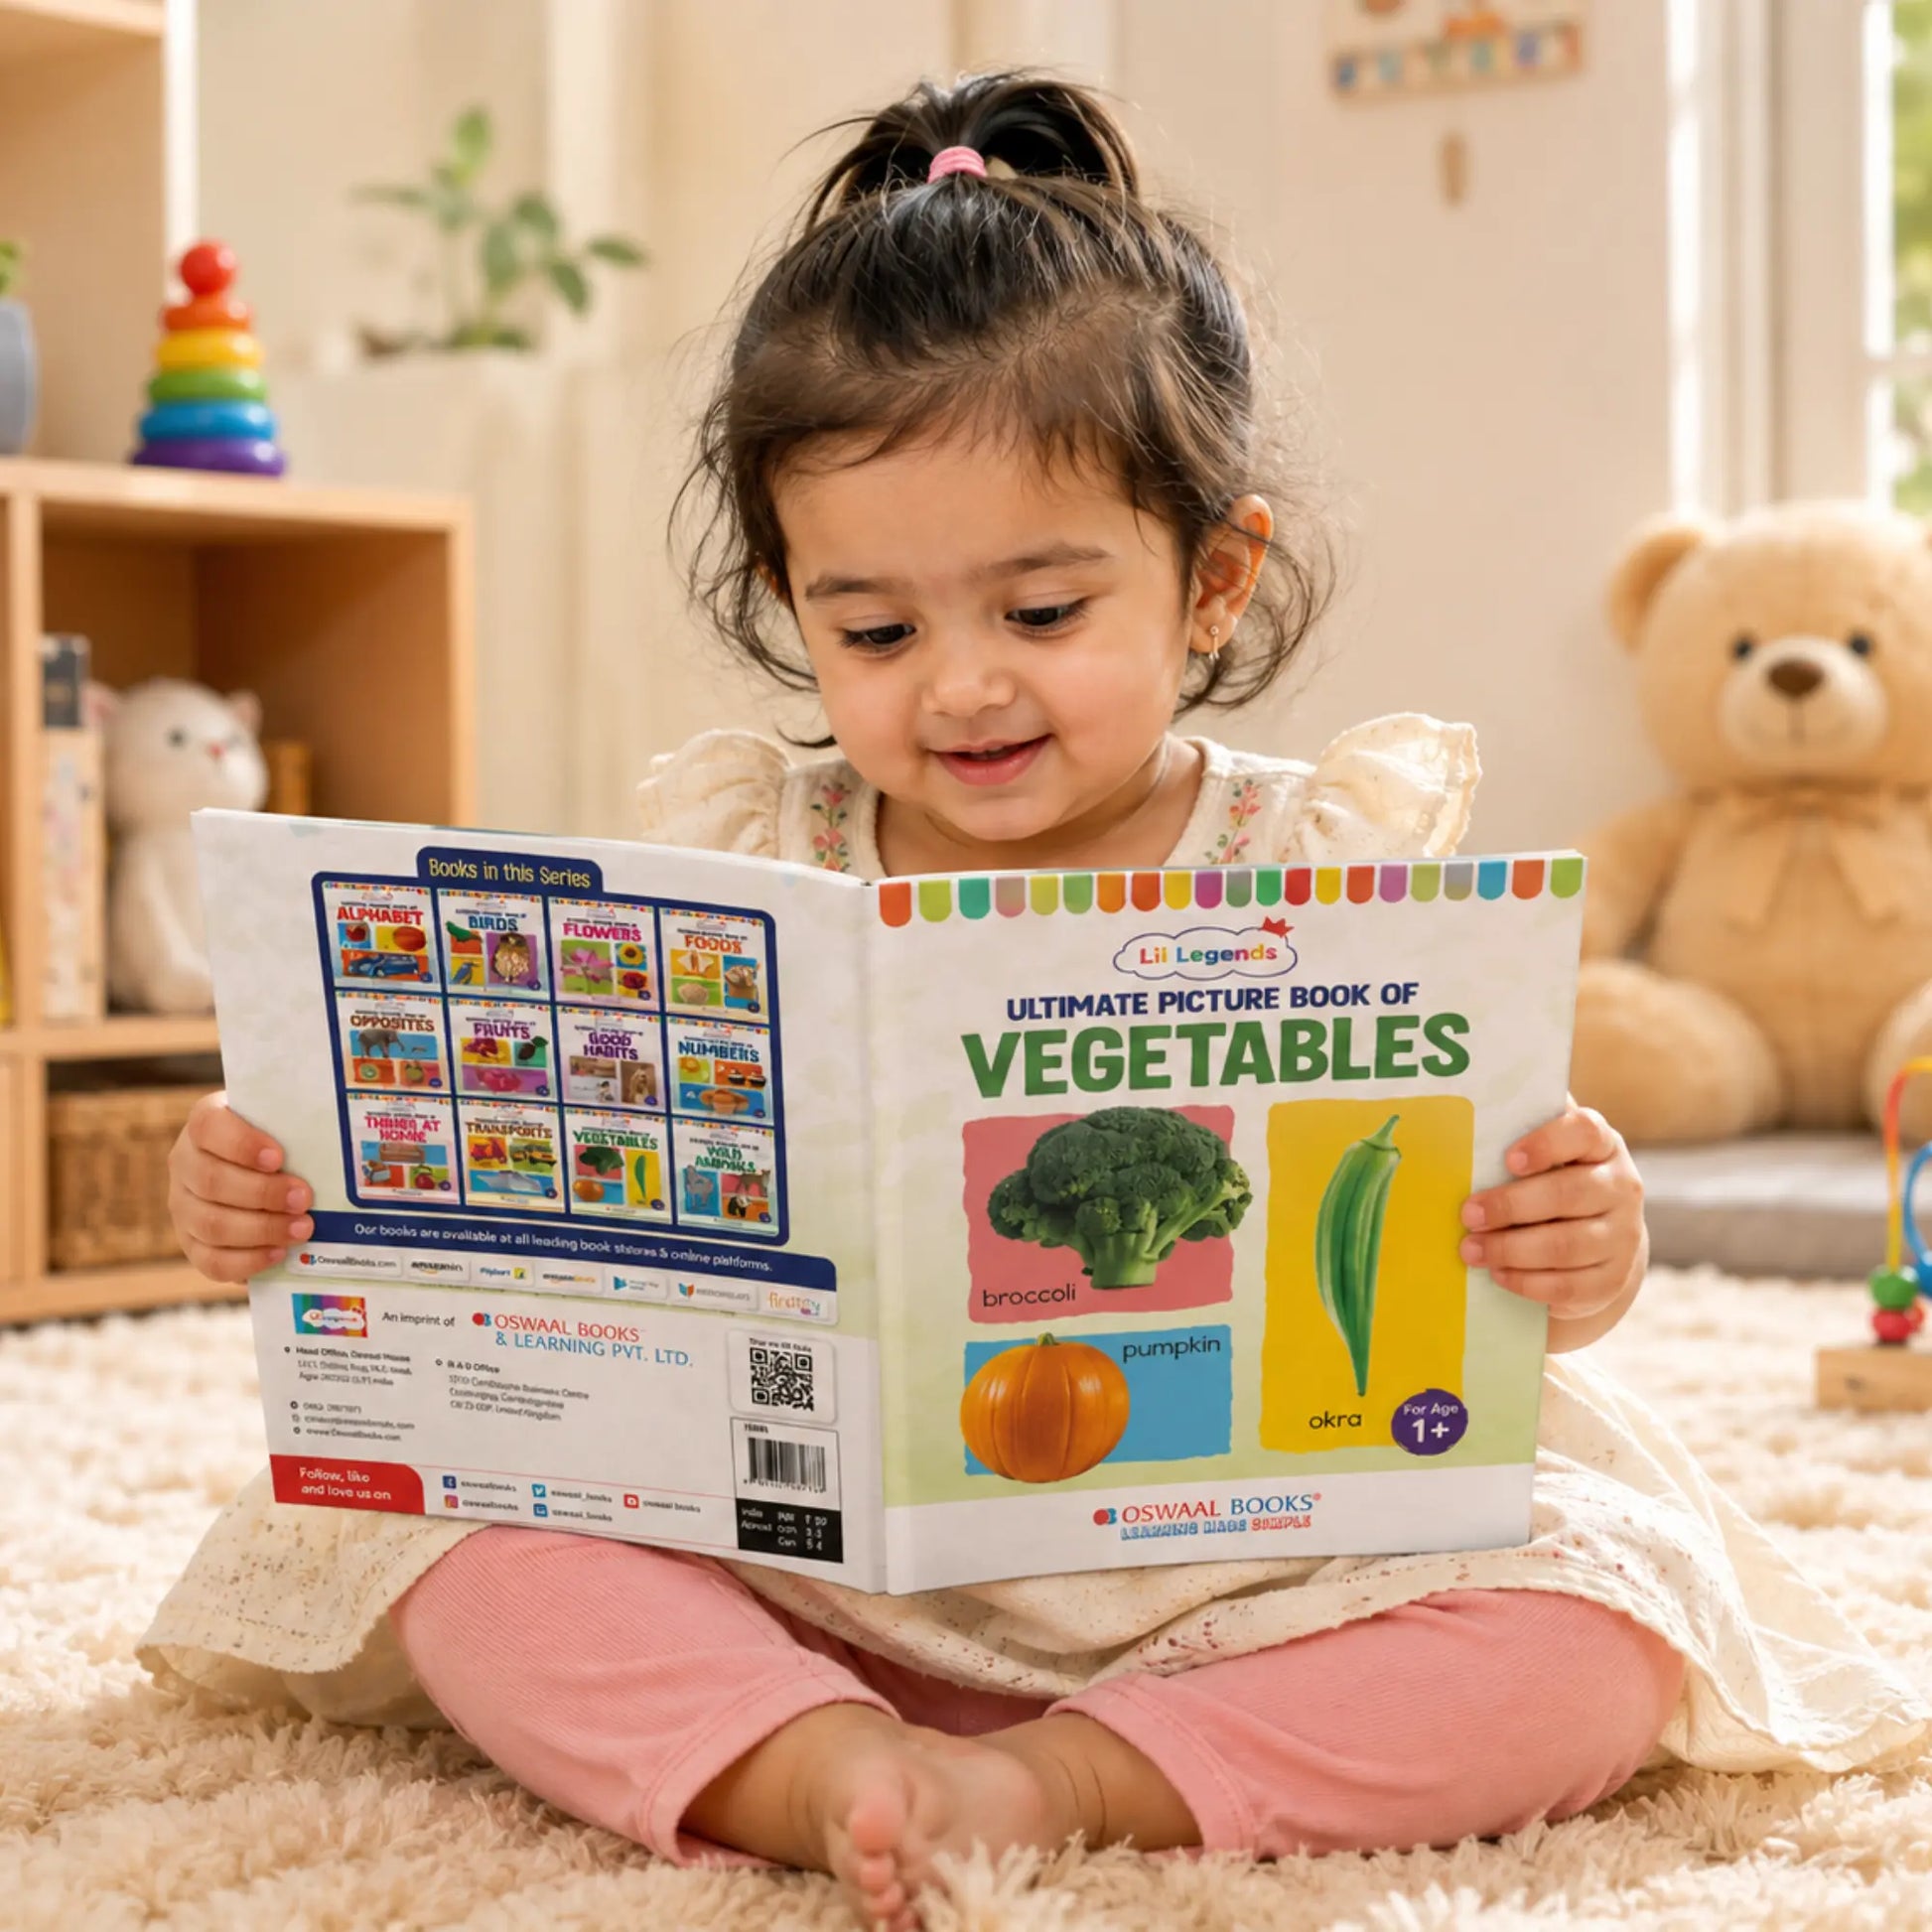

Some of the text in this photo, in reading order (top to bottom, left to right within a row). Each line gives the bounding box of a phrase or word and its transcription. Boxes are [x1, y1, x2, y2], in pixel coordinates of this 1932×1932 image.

[428, 858, 592, 889] Books in this Series
[337, 905, 425, 925] ALPHABET
[468, 915, 518, 932] BIRDS
[562, 922, 642, 943] FLOWERS
[684, 934, 744, 954] FOODS
[1139, 944, 1278, 966] Lil Legends
[1007, 982, 1420, 1022] ULTIMATE PICTURE BOOK OF
[349, 1015, 435, 1034] OPPOSITES
[474, 1023, 531, 1040] FRUITS
[677, 1040, 759, 1063] NUMBERS
[960, 1013, 1471, 1099] VEGETABLES
[422, 1119, 442, 1133] AT
[379, 1224, 417, 1238] books
[420, 1228, 440, 1240] are
[442, 1229, 497, 1243] available
[499, 1233, 512, 1244] at
[515, 1233, 530, 1246] all
[532, 1236, 579, 1252] leading
[580, 1238, 611, 1252] book
[670, 1248, 711, 1265] online
[982, 1283, 1077, 1309] broccoli
[381, 1311, 456, 1327] An imprint of
[494, 1313, 640, 1342] OSWAAL BOOKS
[495, 1331, 694, 1368] & LEARNING PVT. LTD.
[1122, 1335, 1221, 1364] pumpkin
[1309, 1410, 1363, 1431] okra
[1403, 1402, 1459, 1418] For Age
[1411, 1418, 1450, 1444] 1+
[301, 1484, 392, 1501] and love us on
[1121, 1493, 1314, 1524] OSWAAL BOOKS
